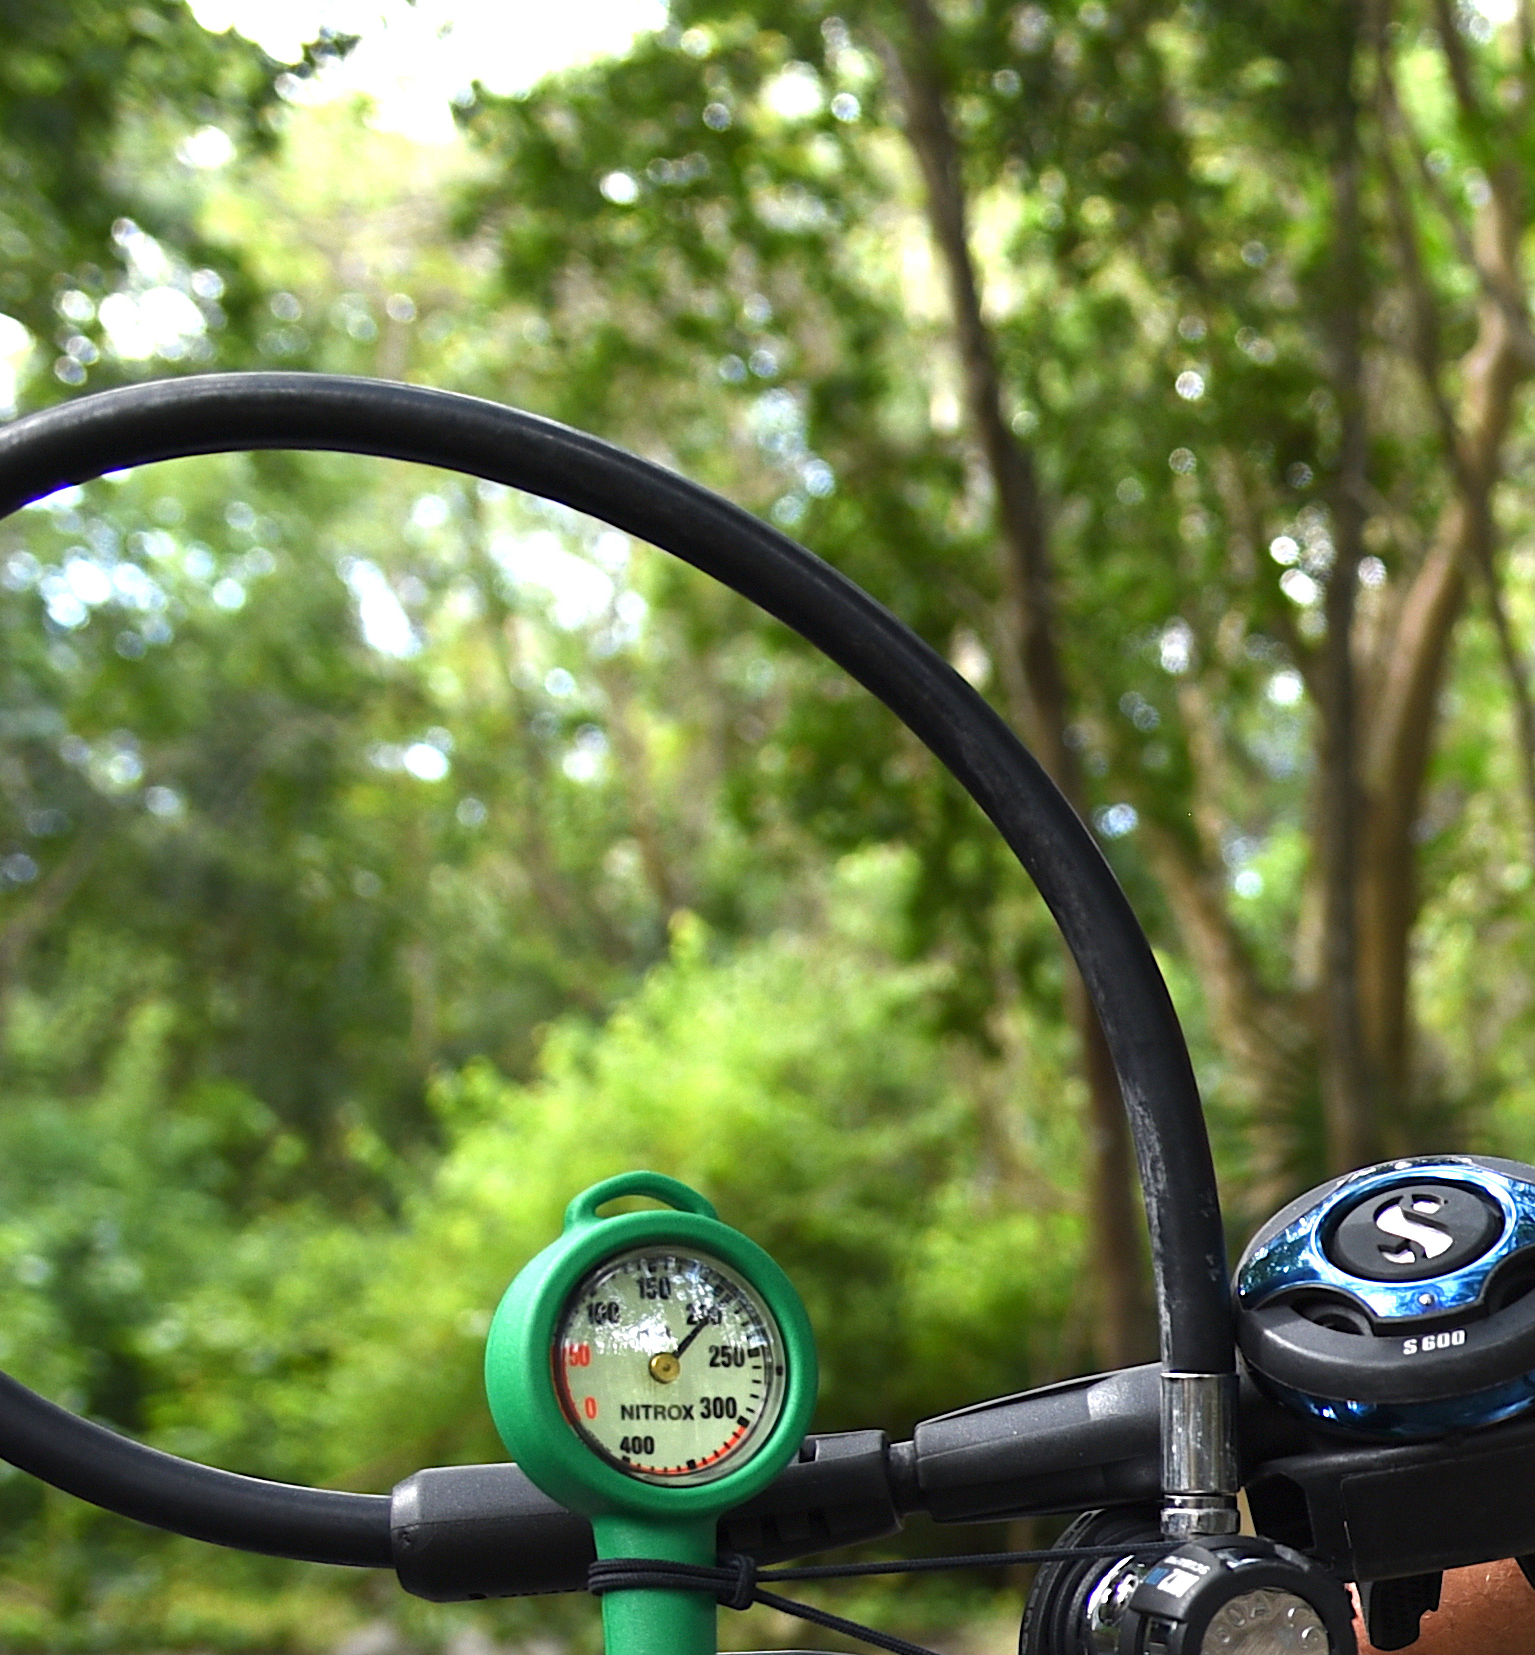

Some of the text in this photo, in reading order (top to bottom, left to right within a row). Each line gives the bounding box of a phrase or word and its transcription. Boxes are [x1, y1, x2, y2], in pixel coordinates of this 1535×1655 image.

[637, 1277, 672, 1299] 150
[588, 1302, 621, 1324] 100
[1403, 1329, 1466, 1355] S 600
[570, 1343, 591, 1367] 50
[709, 1345, 745, 1367] 250
[584, 1396, 597, 1419] 0
[621, 1404, 694, 1420] NITROX
[700, 1397, 737, 1418] 300
[620, 1436, 655, 1455] 400
